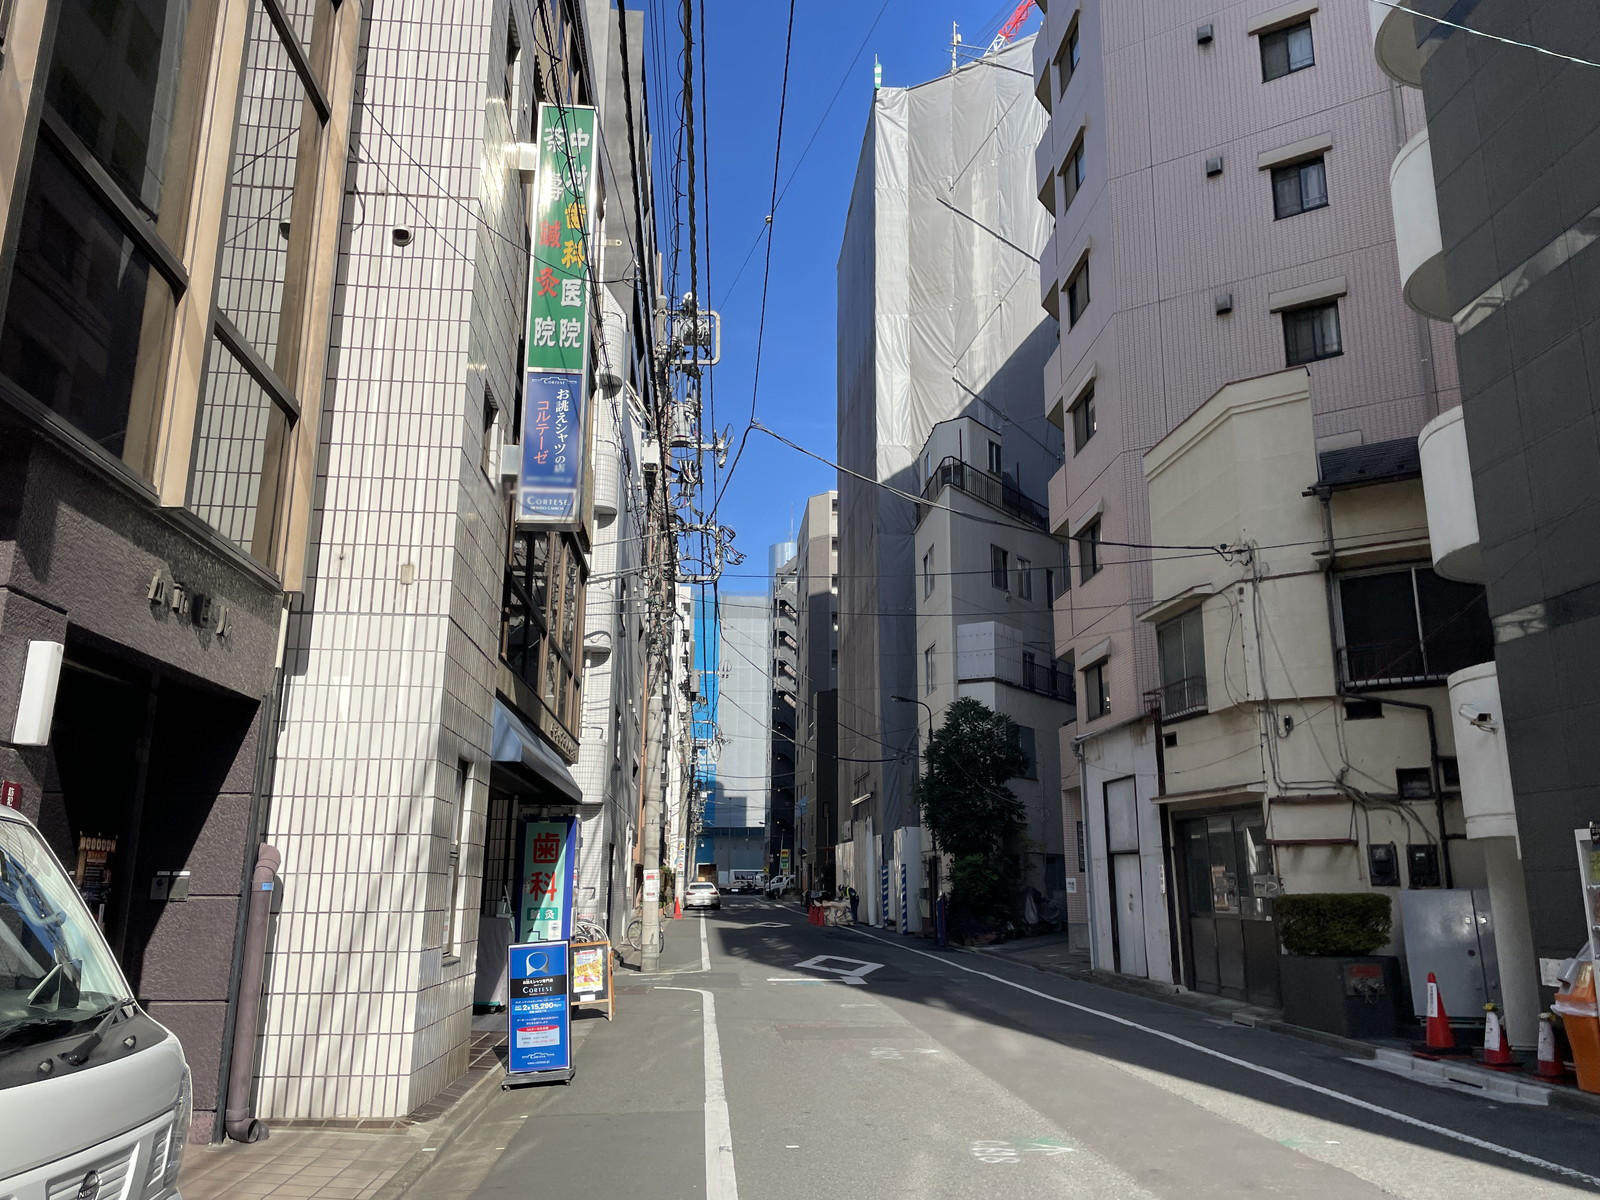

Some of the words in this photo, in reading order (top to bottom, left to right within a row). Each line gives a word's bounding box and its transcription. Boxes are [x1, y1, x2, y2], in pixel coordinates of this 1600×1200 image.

[533, 400, 551, 465] コルテーゼ
[527, 496, 567, 506] CORTESE
[529, 832, 560, 902] 歯科
[529, 908, 555, 920] 鍼灸
